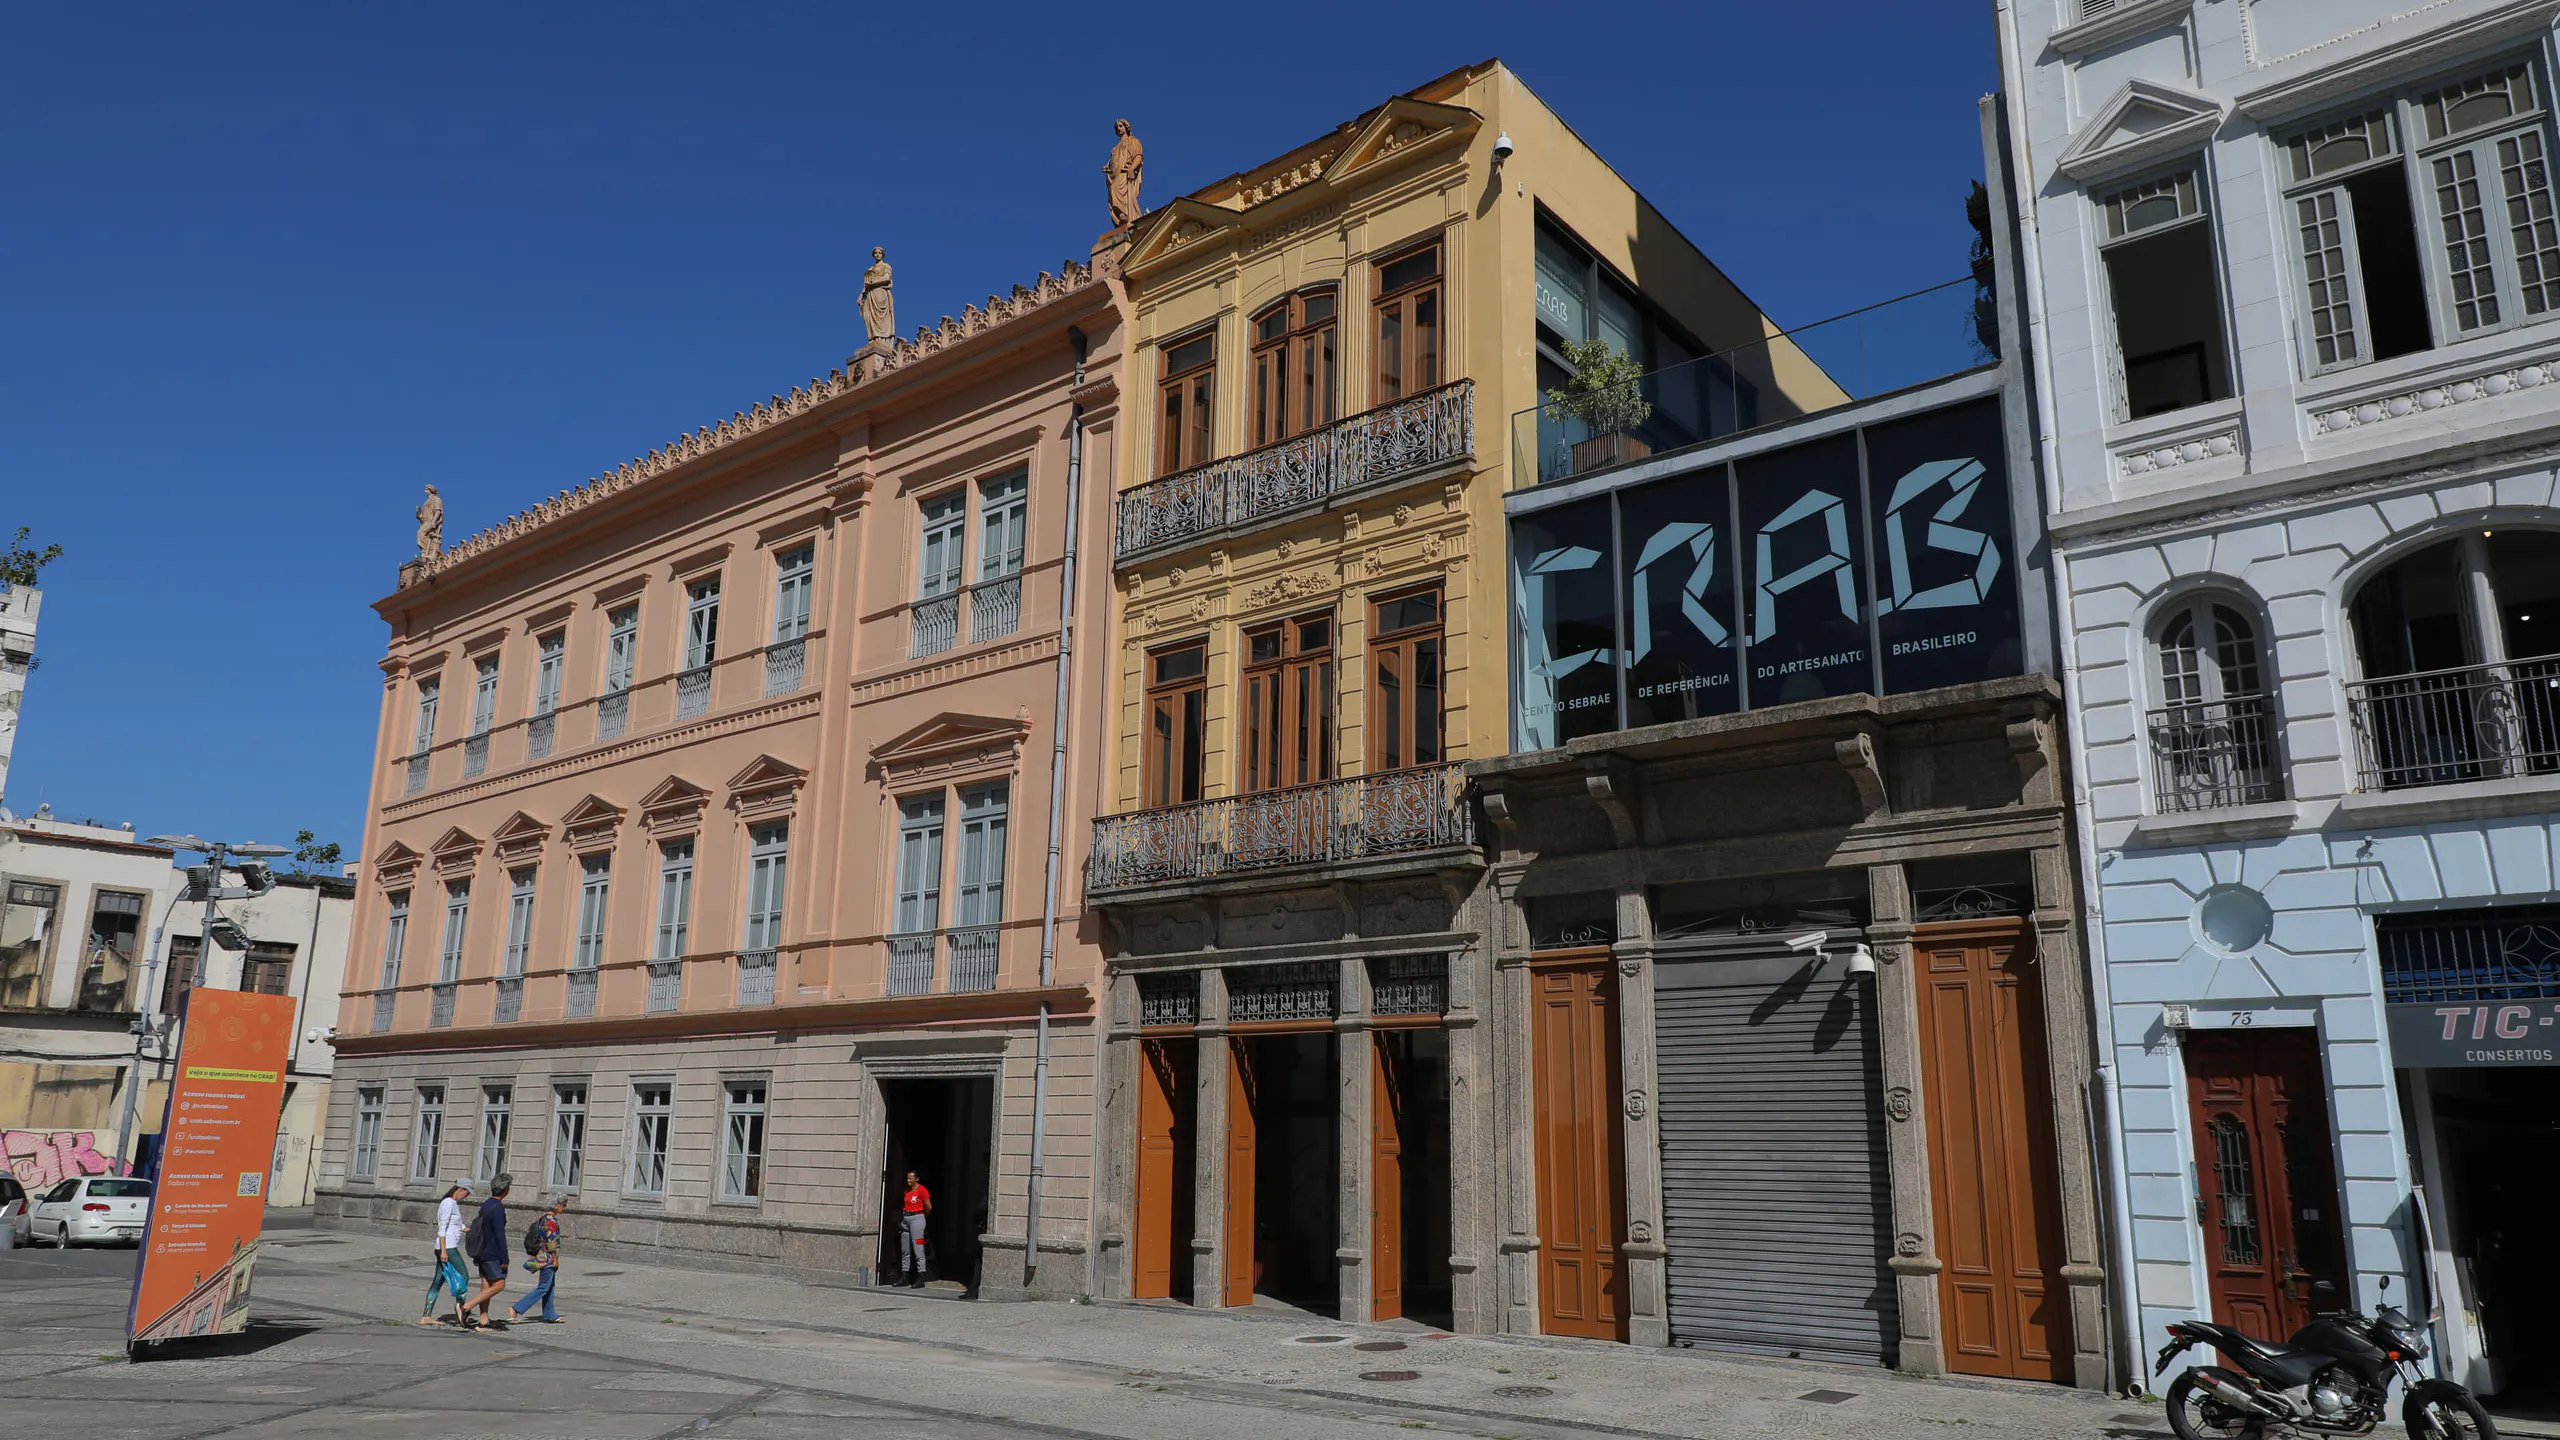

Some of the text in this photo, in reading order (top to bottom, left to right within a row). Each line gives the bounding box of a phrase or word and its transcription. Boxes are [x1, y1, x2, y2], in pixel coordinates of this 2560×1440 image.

[1525, 457, 2001, 680] CRAB
[1523, 631, 1977, 717] CENTRO SEBRAE DE REFERÊNCIA DO ARTESANATO BRASILEIRO
[2231, 1012, 2252, 1026] 73
[2435, 1005, 2560, 1040] TIC-
[2466, 1050, 2553, 1062] CONSERTOS
[189, 1069, 203, 1077] Veja
